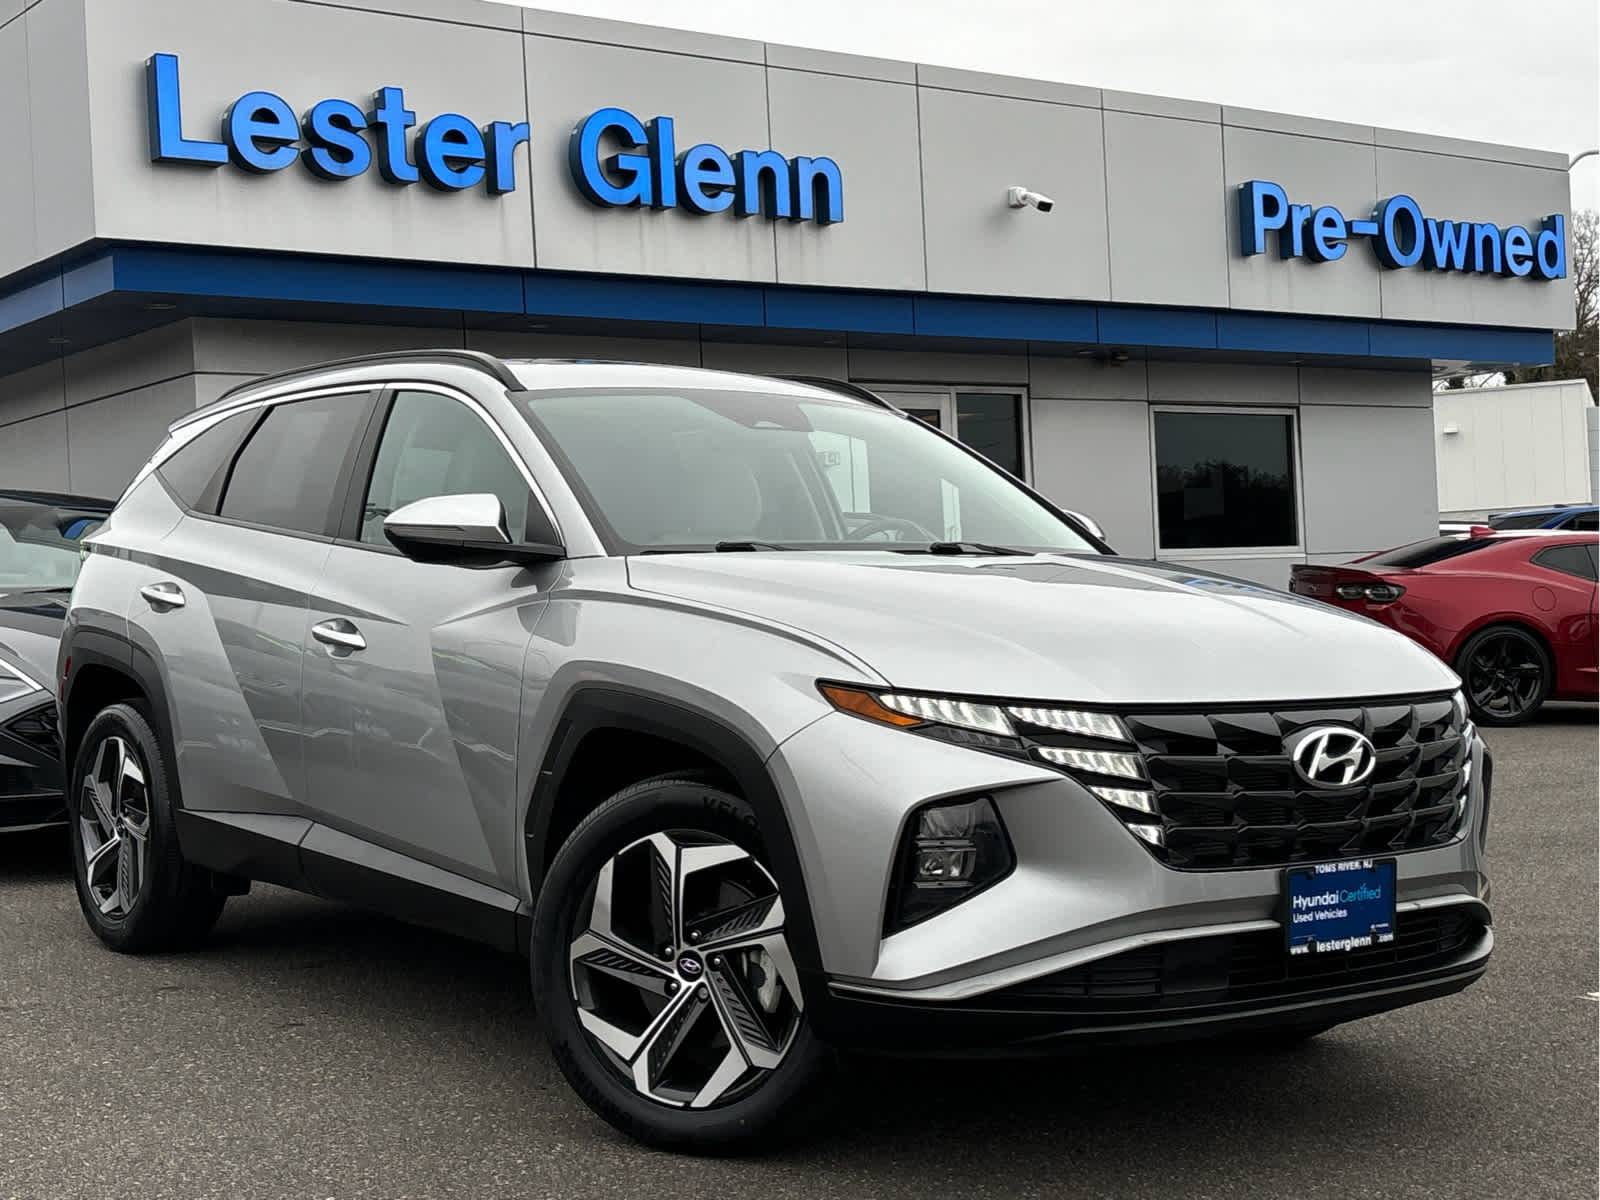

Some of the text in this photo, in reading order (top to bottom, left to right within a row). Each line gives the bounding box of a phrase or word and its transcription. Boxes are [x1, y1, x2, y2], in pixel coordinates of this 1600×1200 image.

[145, 53, 845, 225] Lester Glenn
[1239, 180, 1567, 279] Pre-Owned
[1315, 863, 1336, 874] TOMS
[1363, 859, 1373, 869] NJ
[1292, 883, 1381, 911] Hyundai Certified
[1292, 908, 1347, 923] Used Vehicles
[1316, 936, 1372, 953] lesterglenn
